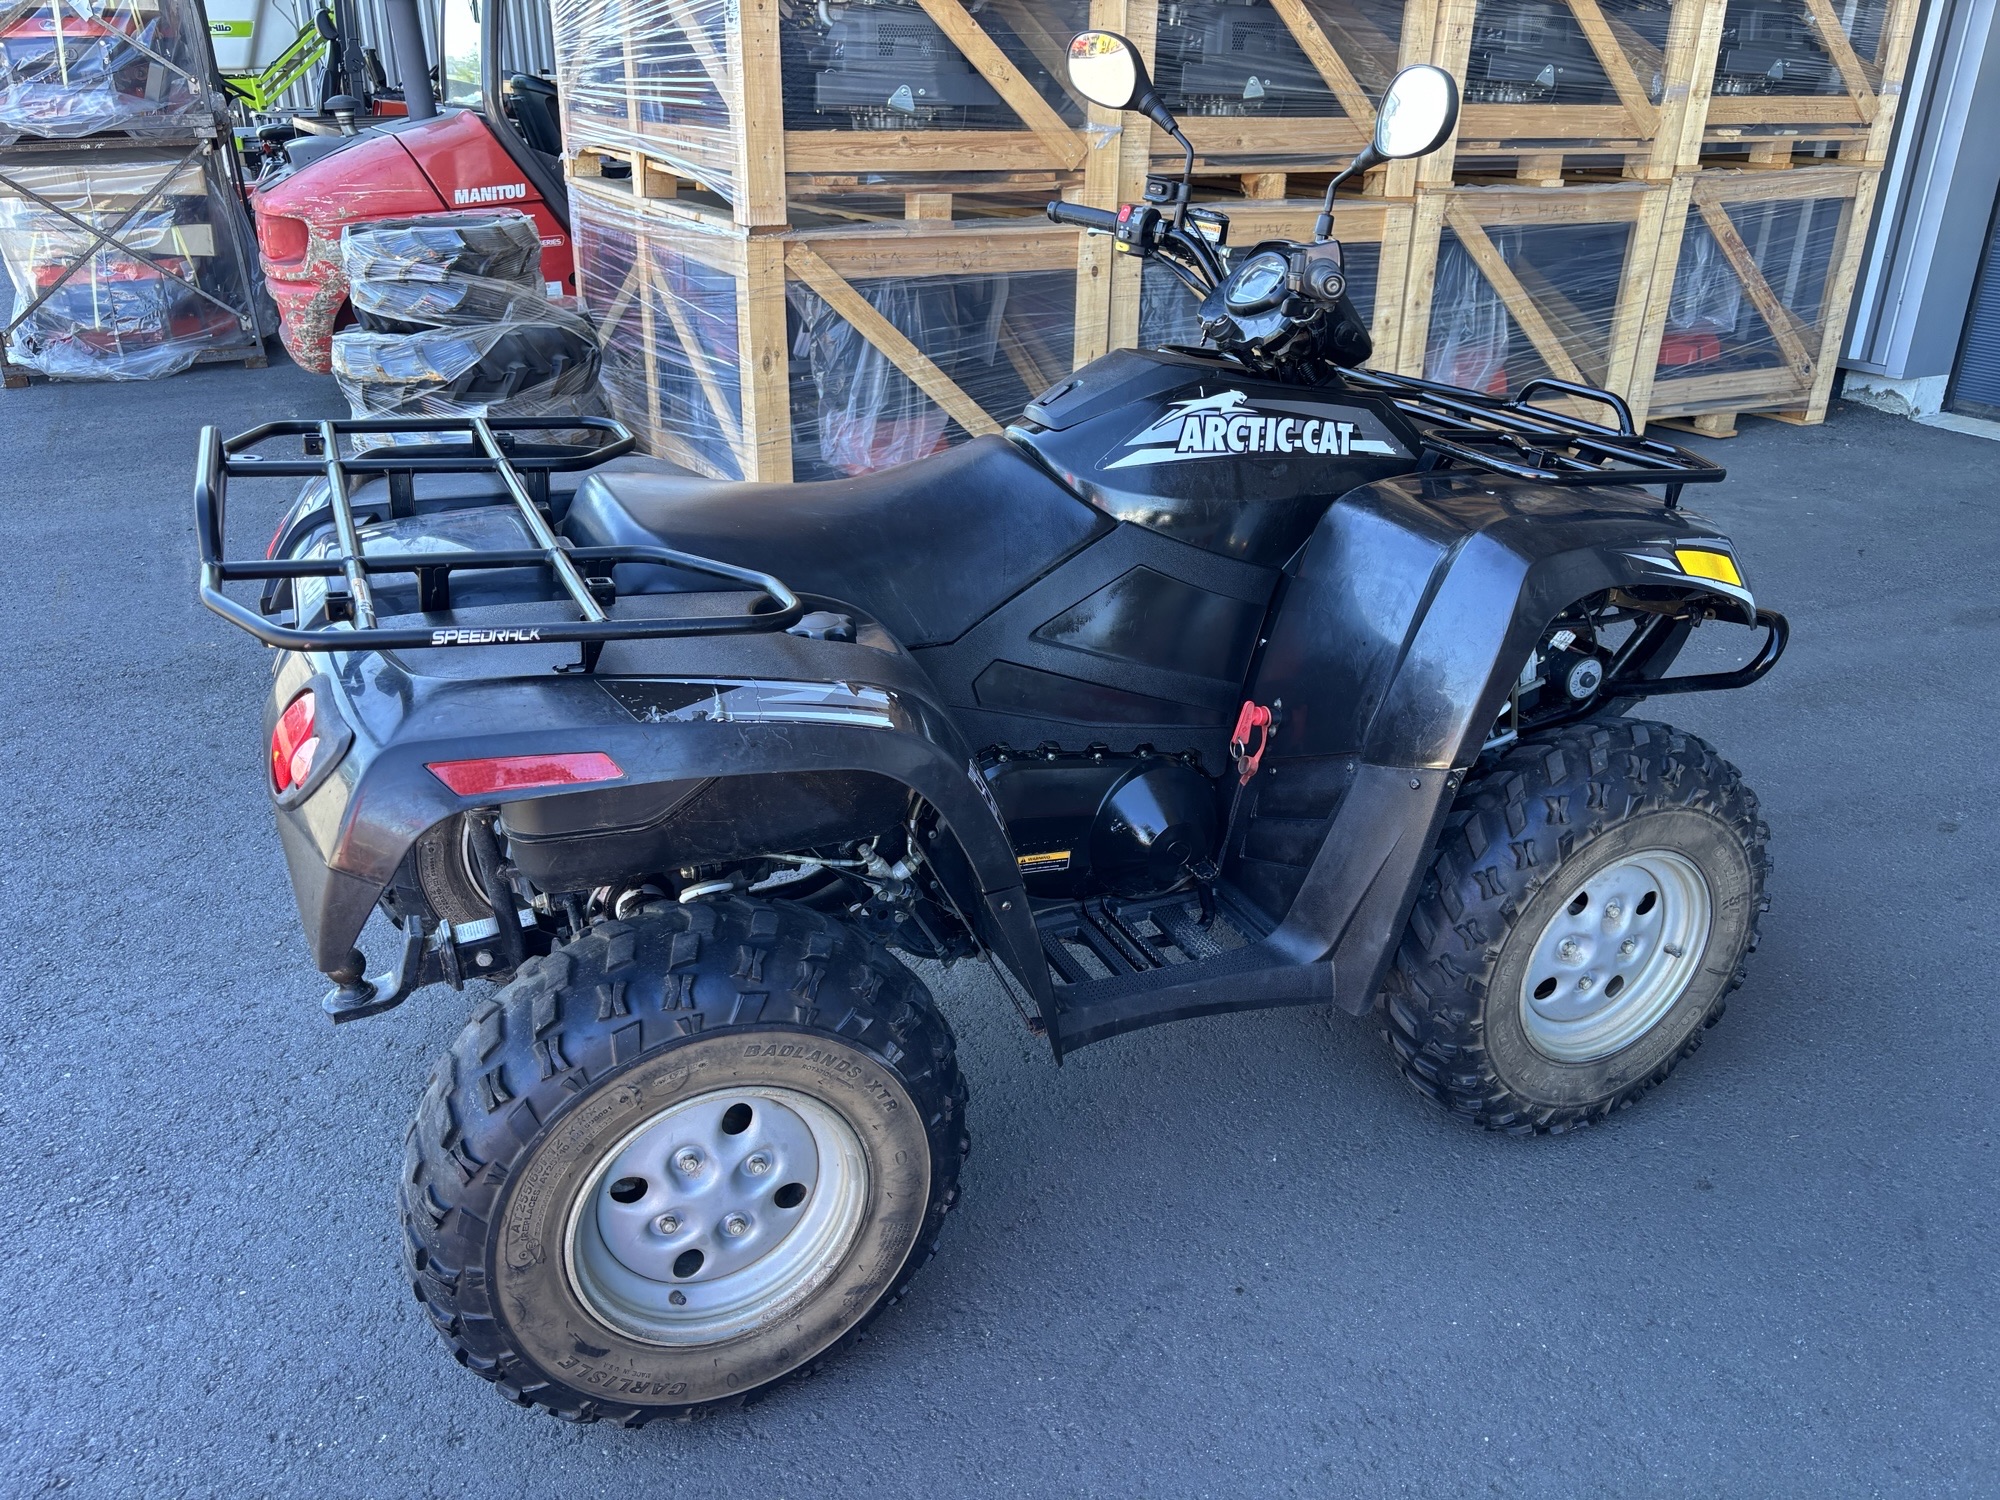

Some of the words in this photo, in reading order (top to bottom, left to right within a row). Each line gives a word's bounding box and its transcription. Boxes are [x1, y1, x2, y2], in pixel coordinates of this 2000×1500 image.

[454, 183, 526, 204] MANITOU
[1499, 202, 1521, 219] LA
[431, 627, 541, 646] SPEEDRACK
[743, 1044, 862, 1079] BADLANDS
[865, 1080, 898, 1112] XTR
[801, 1064, 834, 1079] ROTATION
[557, 1354, 687, 1396] CARLISLE
[632, 1371, 652, 1379] MADE
